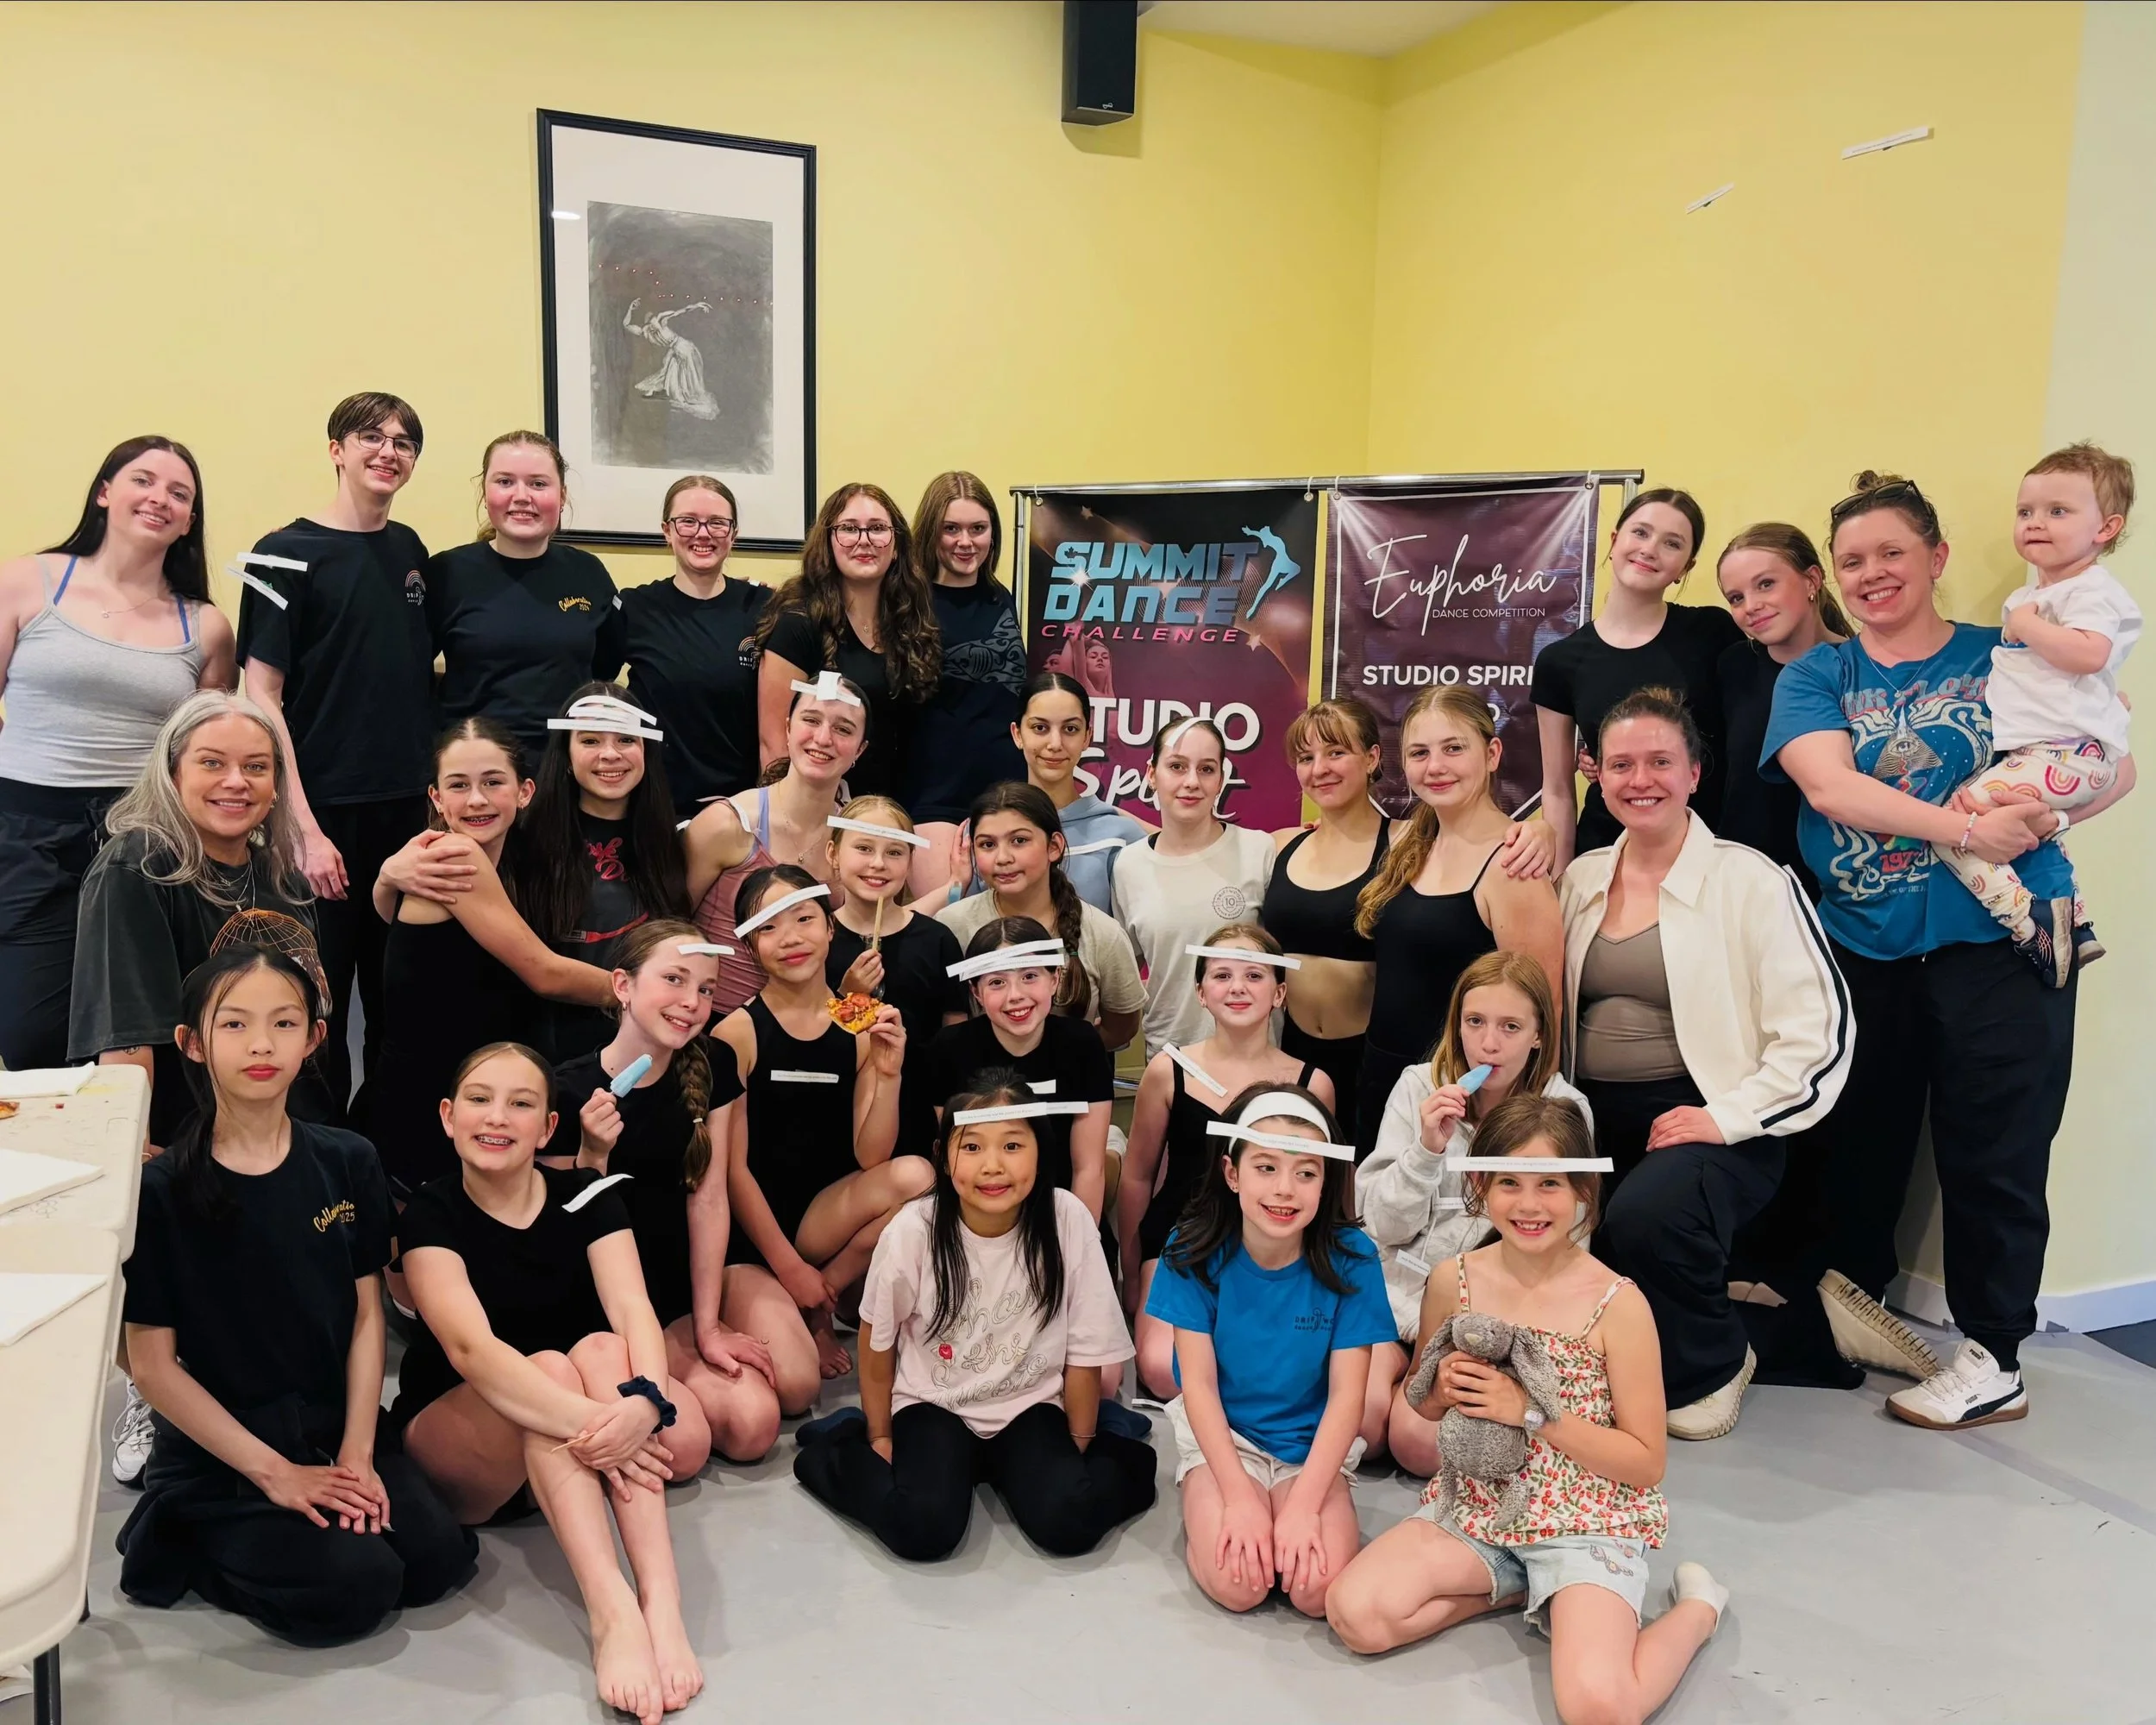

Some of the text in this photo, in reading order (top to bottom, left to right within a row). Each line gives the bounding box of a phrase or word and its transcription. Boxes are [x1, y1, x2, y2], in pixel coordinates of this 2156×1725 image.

[1050, 542, 1260, 581] SUMMIT
[1364, 534, 1557, 637] Euphoria
[1043, 584, 1240, 626] DANCE
[1432, 607, 1546, 618] DANCE COMPETITION
[1041, 624, 1239, 643] CHALLENGE
[1362, 665, 1534, 687] STUDIO SPIRI
[1879, 850, 1924, 874] 197
[1225, 897, 1236, 906] 10
